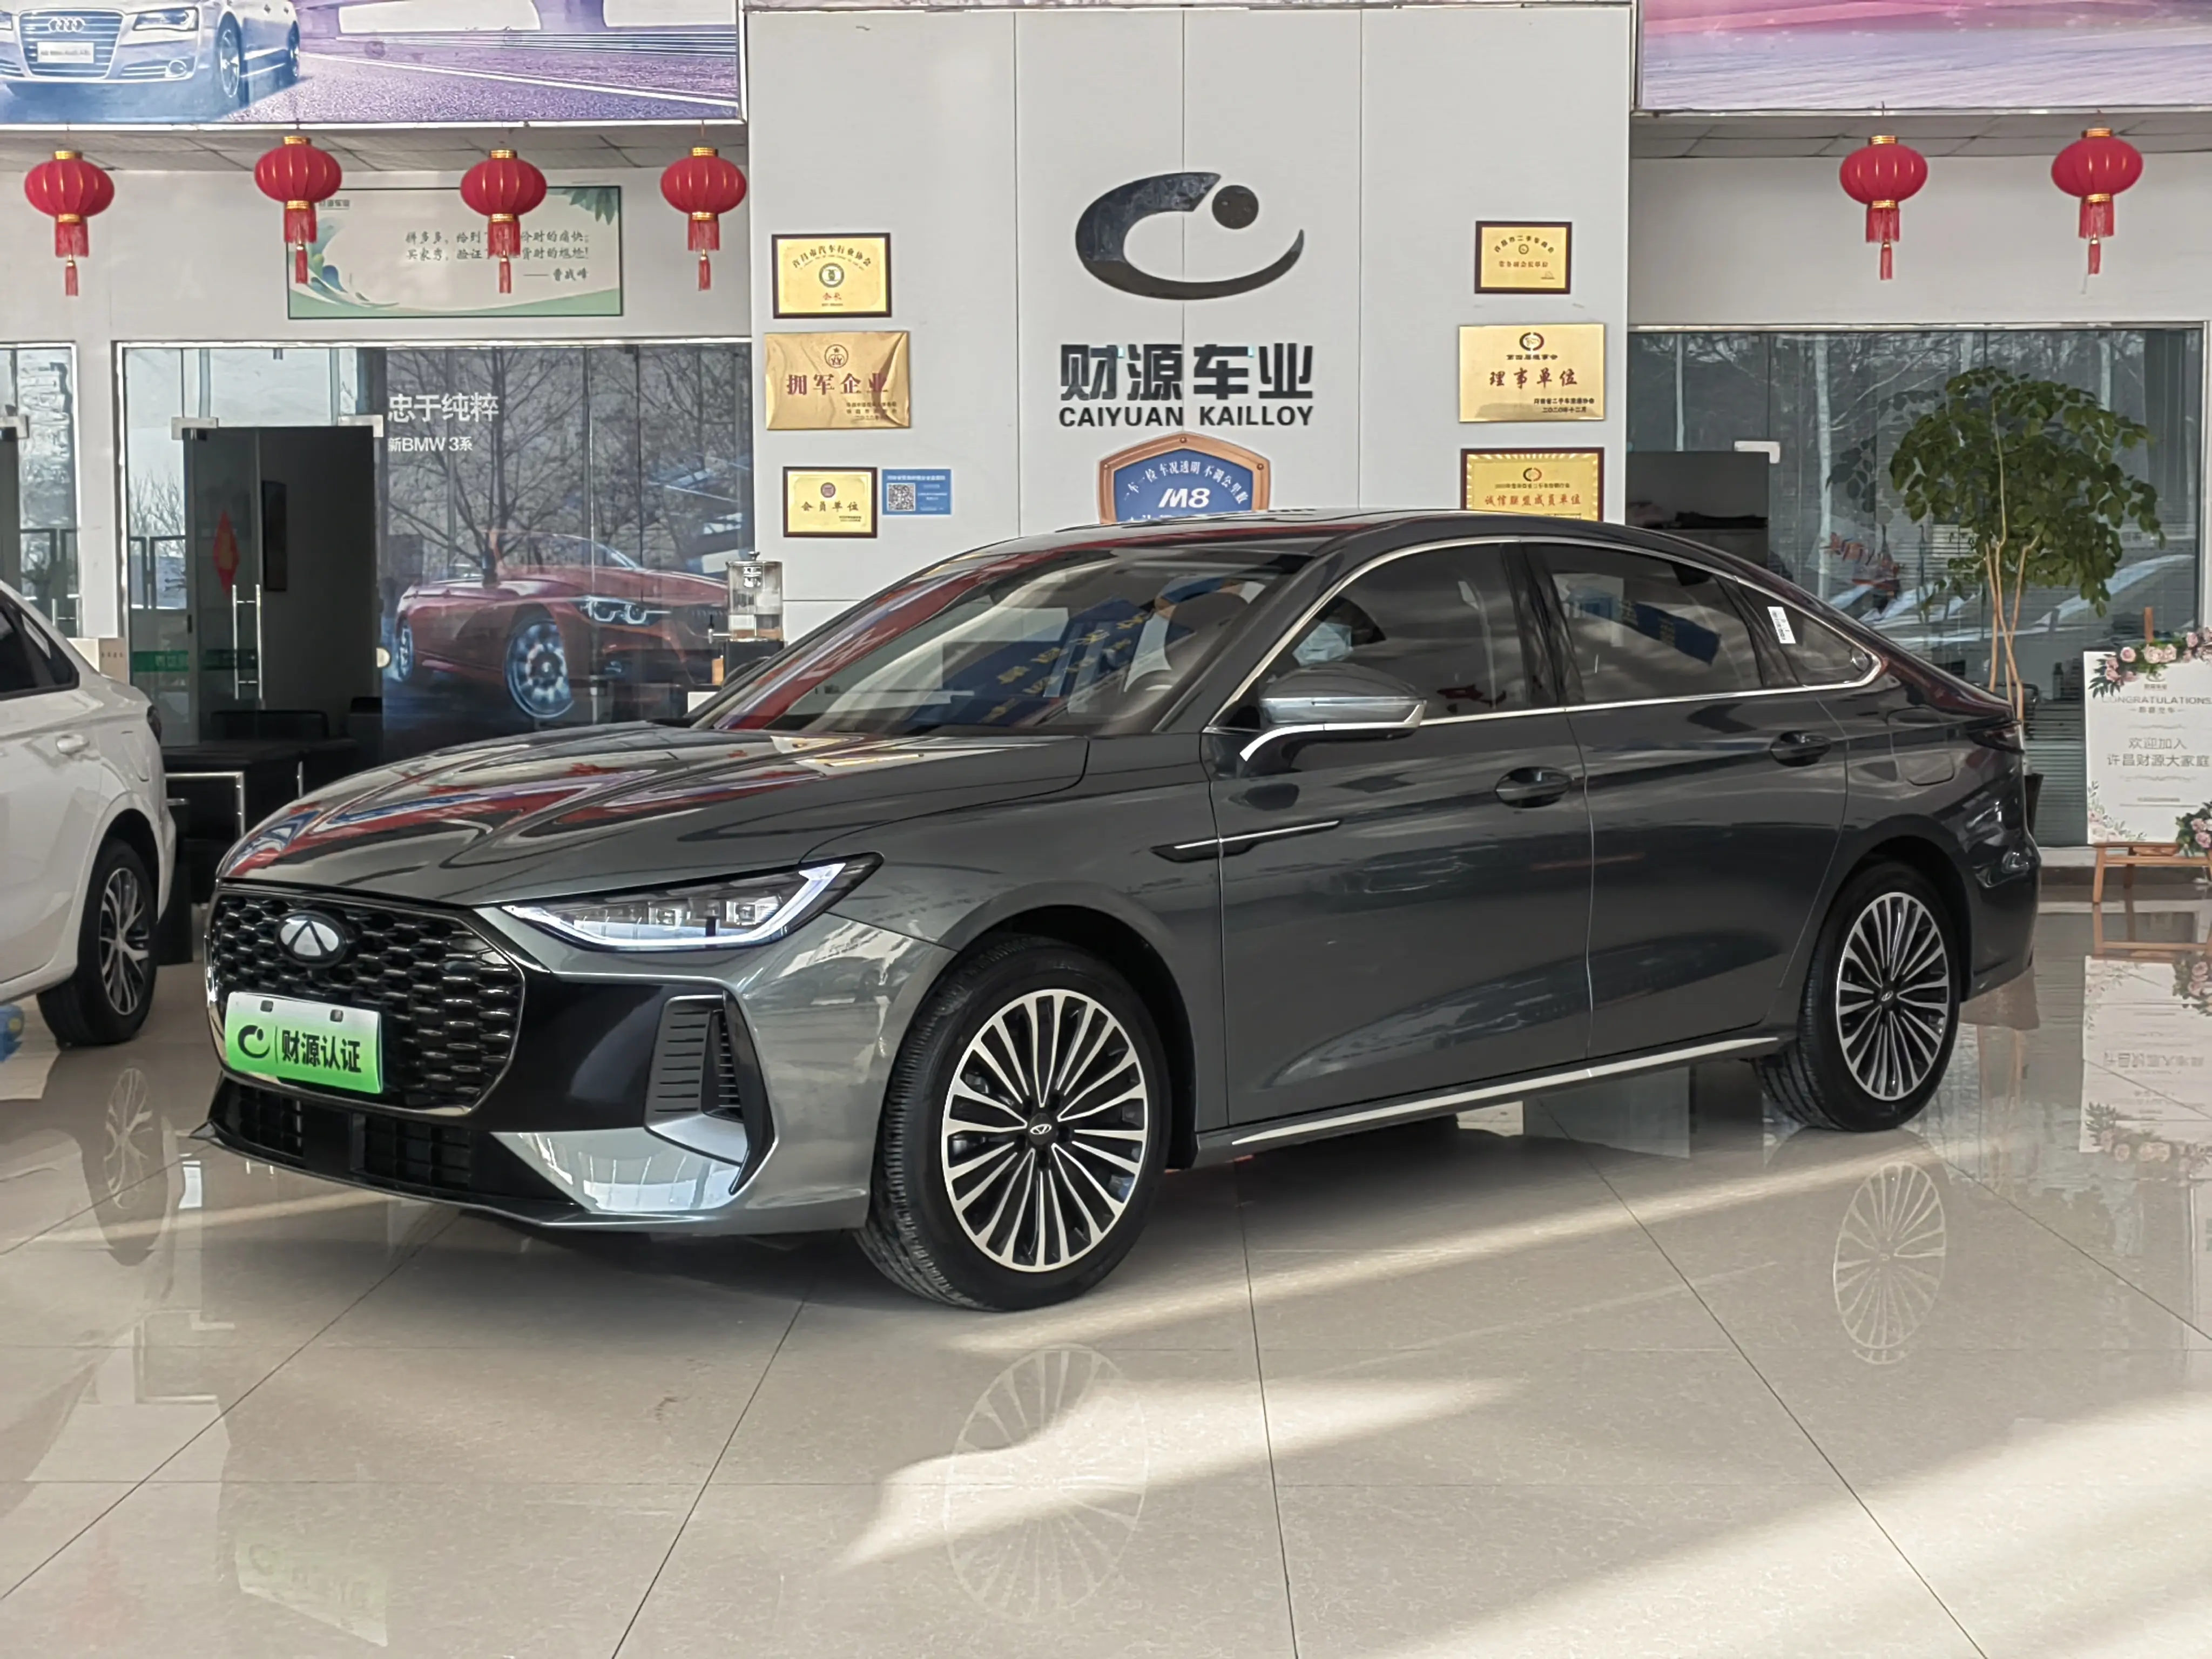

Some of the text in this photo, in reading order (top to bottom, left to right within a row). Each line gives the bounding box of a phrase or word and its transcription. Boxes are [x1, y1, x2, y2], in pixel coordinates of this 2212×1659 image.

[1061, 342, 1313, 400] 财源车业
[1489, 367, 1577, 389] 理事单位
[786, 373, 889, 395] 拥军企业
[387, 392, 499, 423] 忠于纯粹
[1059, 406, 1313, 427] CAIYUAN KAILLOY
[387, 436, 473, 452] 新BMW 3系
[1159, 460, 1202, 476] 车况透明
[1203, 464, 1249, 504] 不调公里数
[801, 501, 859, 512] 会员单位
[1158, 488, 1211, 508] M8
[2128, 737, 2187, 750] 欢迎加入
[2106, 753, 2210, 767] 许昌财源大家庭
[281, 1029, 362, 1073] 财源认证
